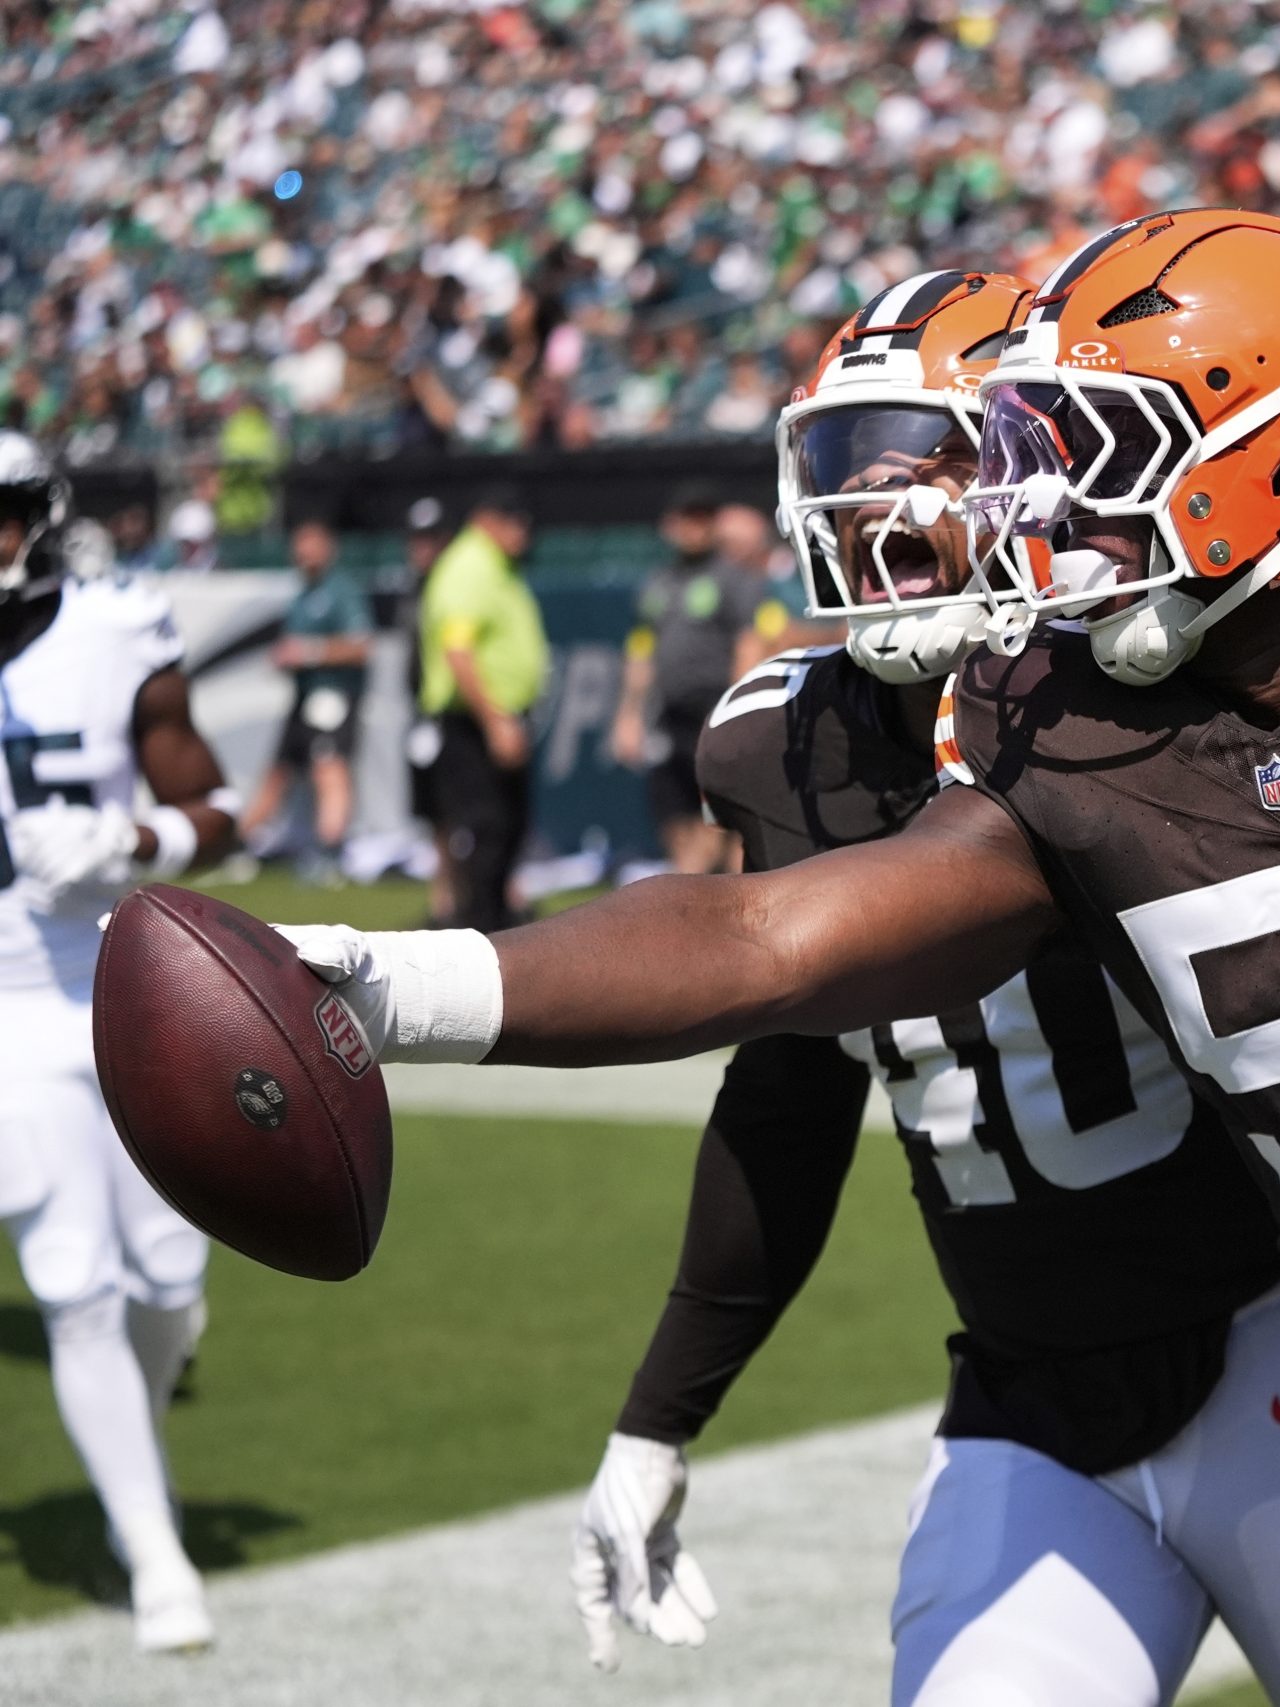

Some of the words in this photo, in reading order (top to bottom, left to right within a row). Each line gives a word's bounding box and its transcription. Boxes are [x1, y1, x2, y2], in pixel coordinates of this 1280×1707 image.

[1062, 357, 1120, 368] OAKLEY
[323, 1001, 366, 1071] NFL
[838, 963, 1194, 1204] 40
